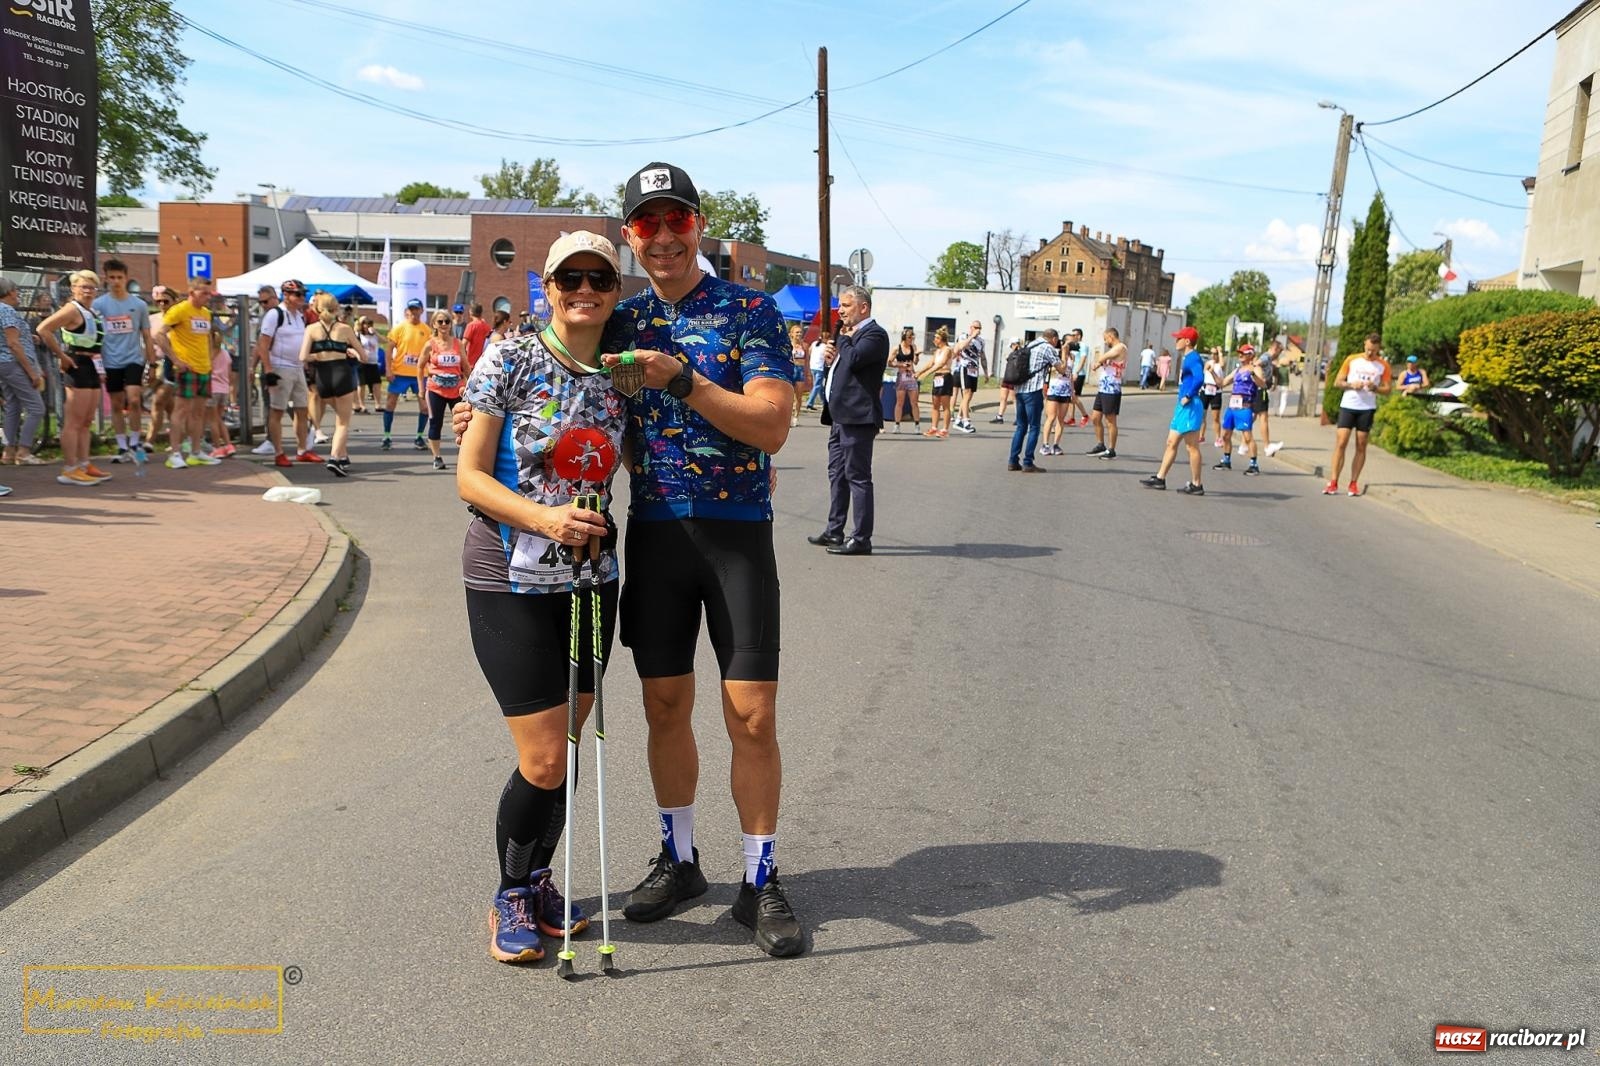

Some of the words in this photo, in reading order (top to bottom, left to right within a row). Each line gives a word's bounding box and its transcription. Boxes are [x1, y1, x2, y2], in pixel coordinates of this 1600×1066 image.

[14, 0, 76, 21] SiR
[36, 13, 77, 32] RACIBÓRZ
[8, 76, 86, 107] H2OSTRÓG
[16, 104, 80, 130] STADION
[21, 124, 76, 146] MIEJSKI
[25, 149, 73, 169] KORTY
[11, 165, 85, 189] TENISOWE
[9, 190, 89, 213] KRĘGIELNIA
[11, 215, 87, 237] SKATEPARK
[192, 255, 207, 277] P
